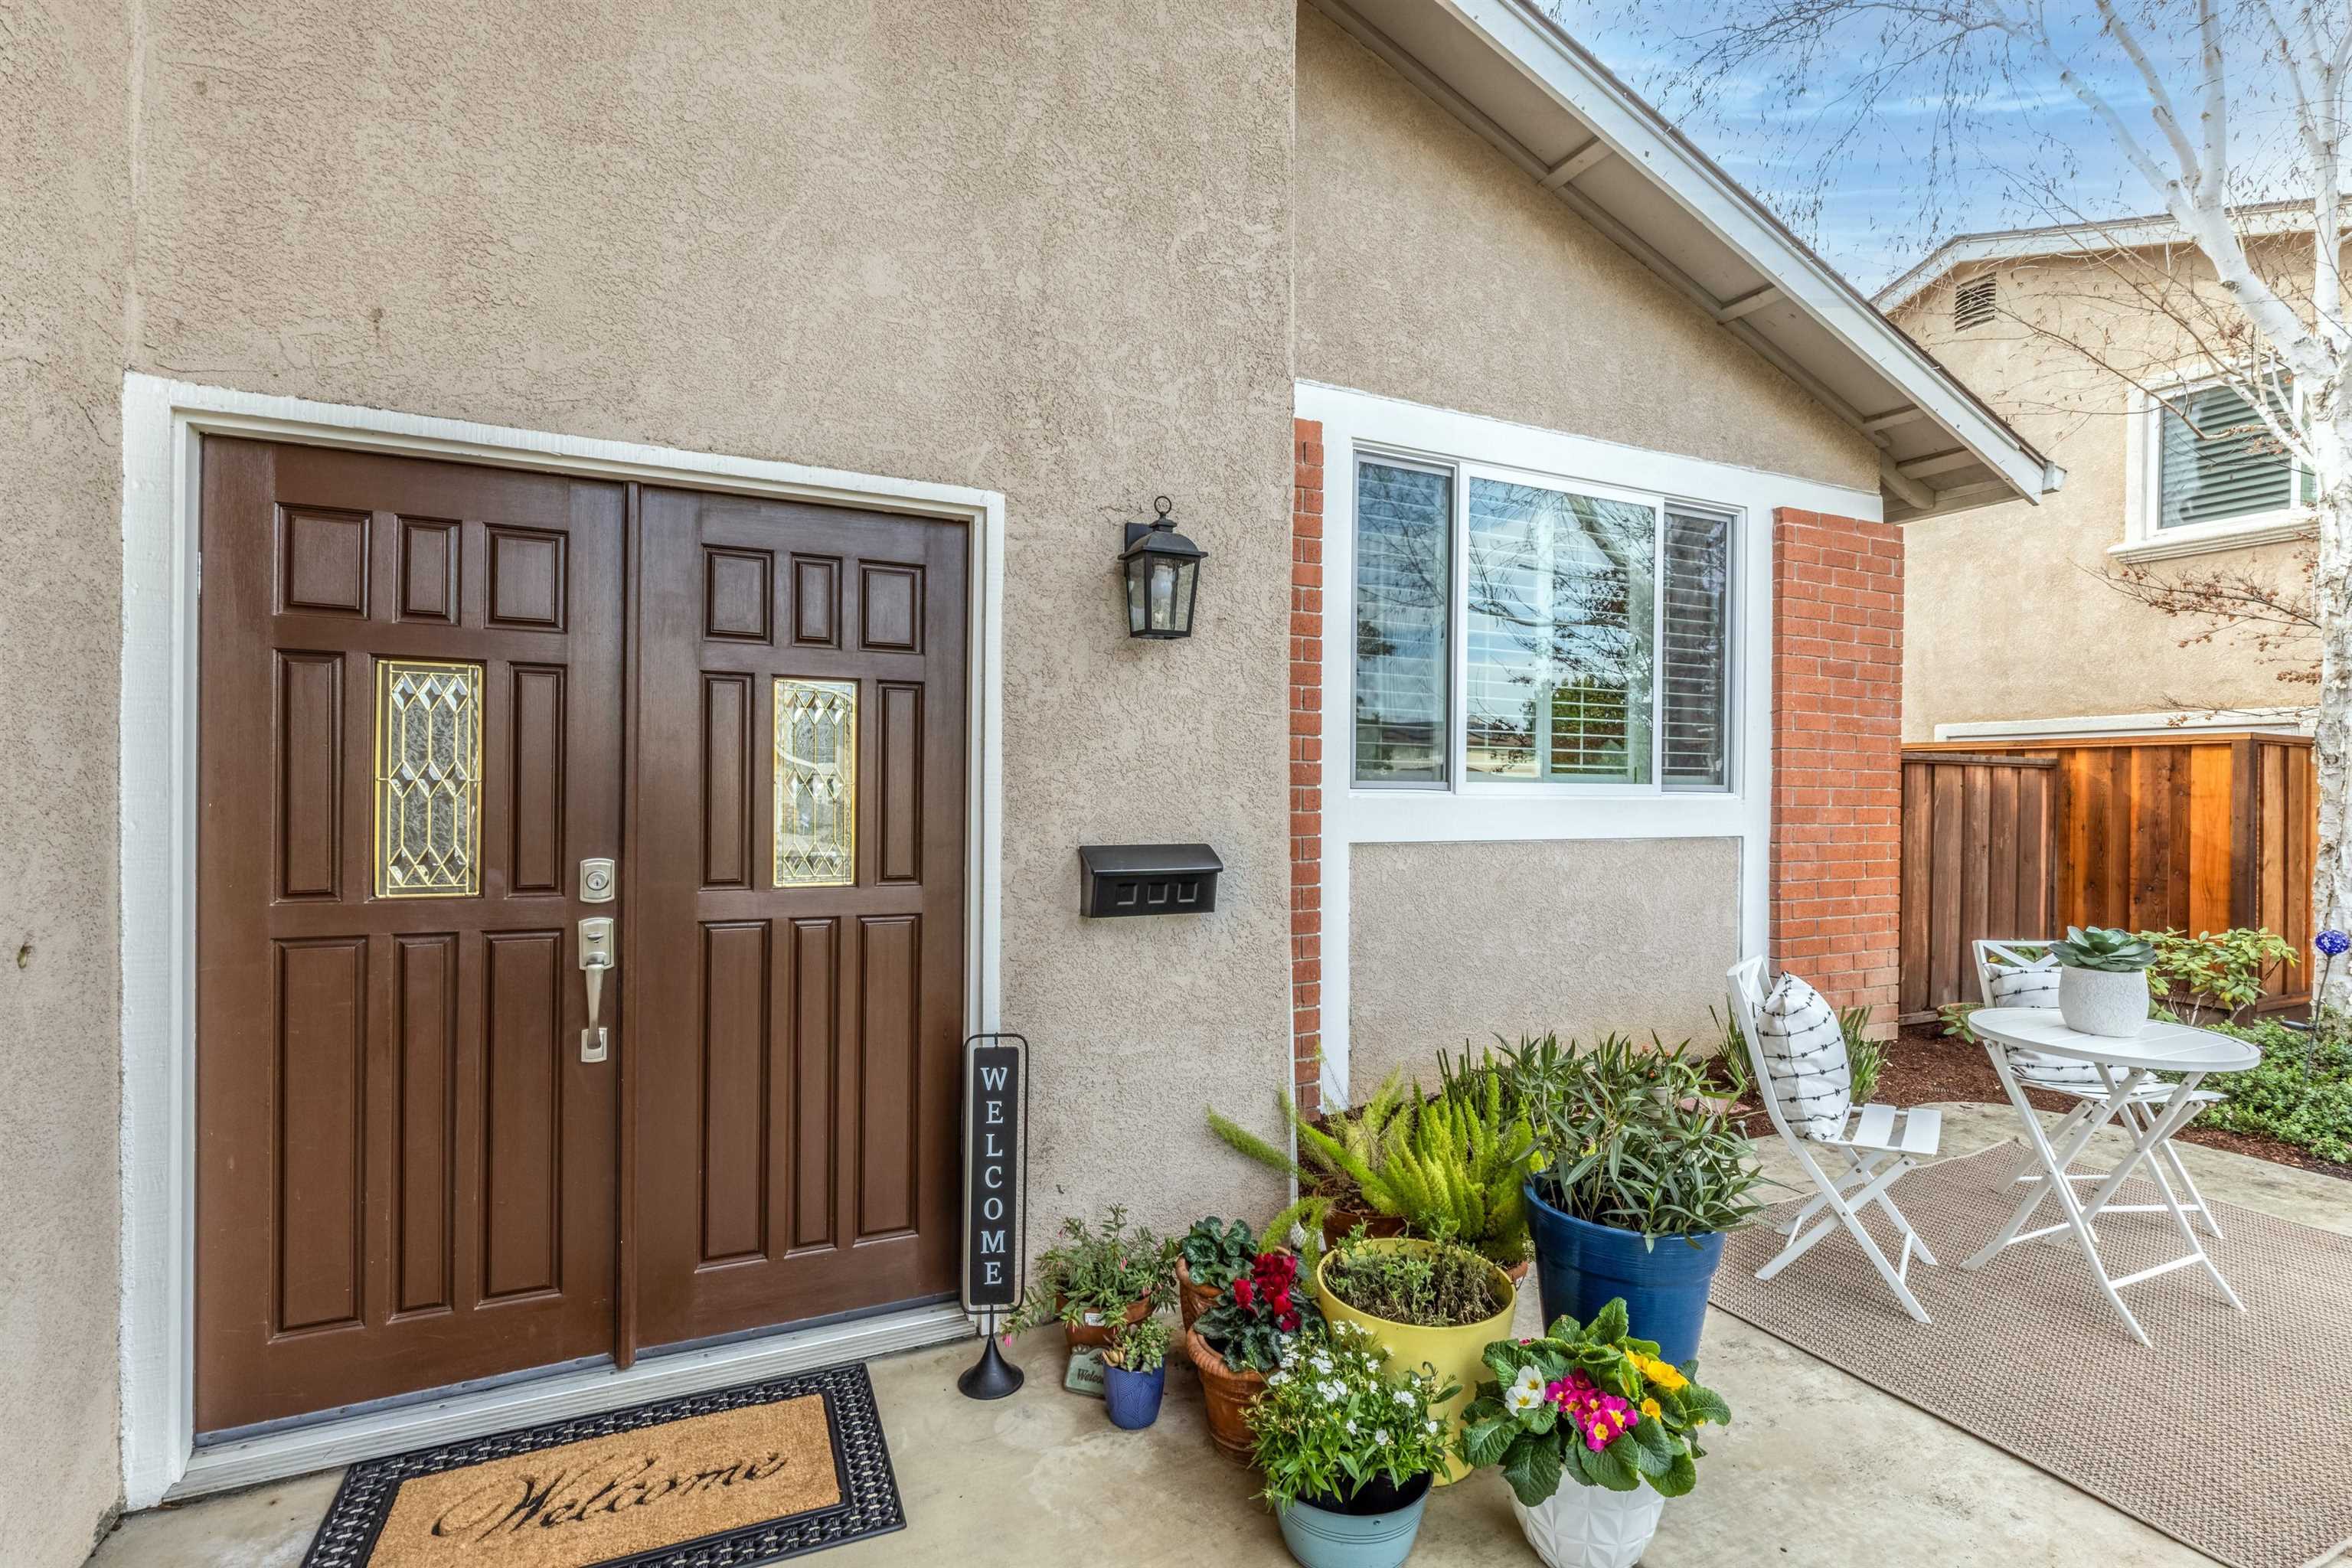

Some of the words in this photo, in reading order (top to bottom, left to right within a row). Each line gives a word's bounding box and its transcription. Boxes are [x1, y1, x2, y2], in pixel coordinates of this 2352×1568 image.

[980, 1067, 1008, 1285] WELCOME
[1077, 1368, 1103, 1384] Welco
[431, 1454, 787, 1542] Welcome
